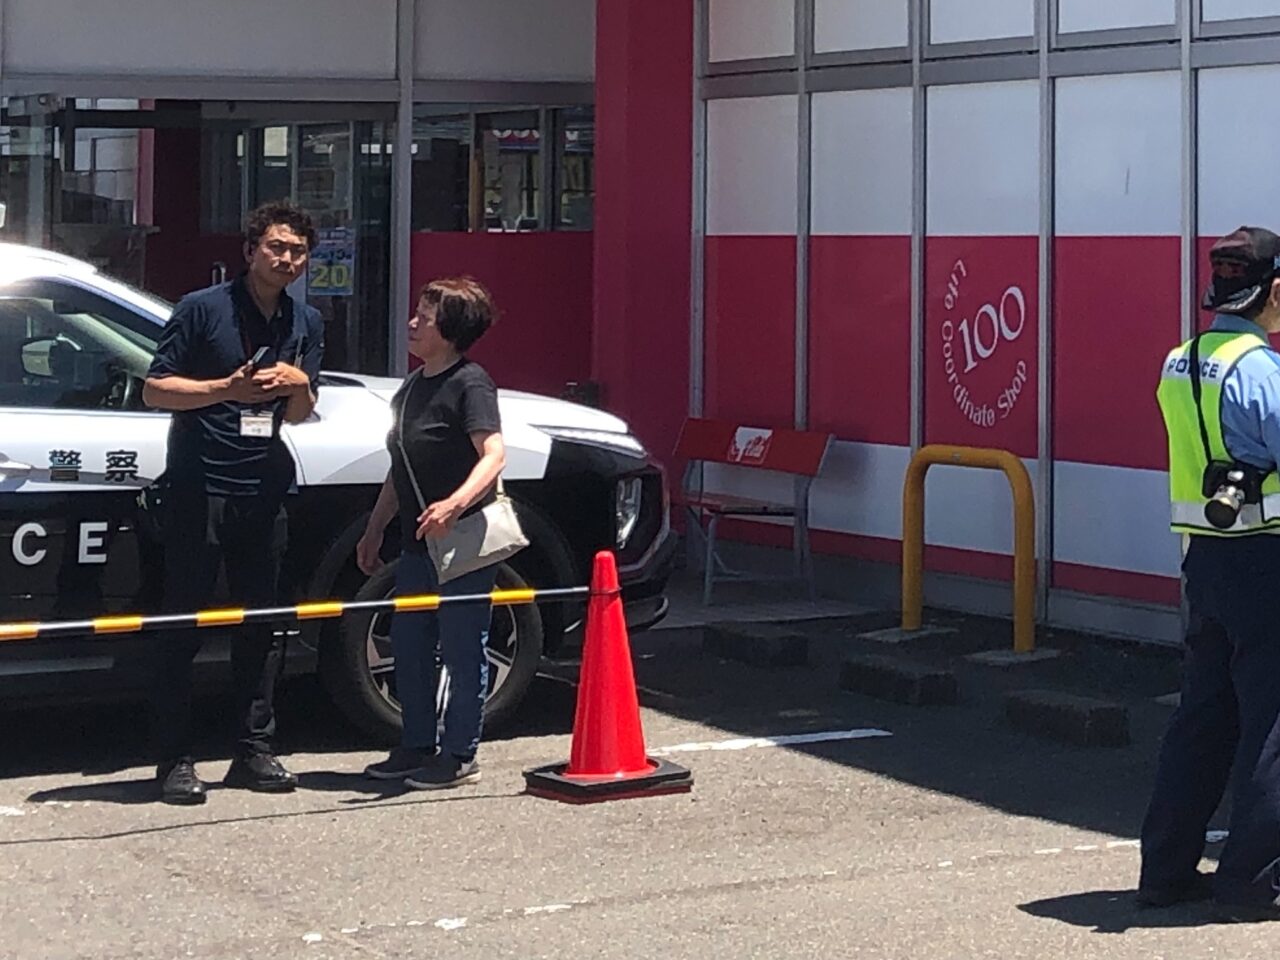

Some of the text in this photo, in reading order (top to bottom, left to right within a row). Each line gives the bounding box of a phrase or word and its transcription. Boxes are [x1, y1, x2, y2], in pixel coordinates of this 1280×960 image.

[942, 259, 1027, 428] Life Coordinate Shop
[958, 286, 1025, 374] 100
[1166, 358, 1219, 379] POCE
[49, 450, 139, 482] 警察
